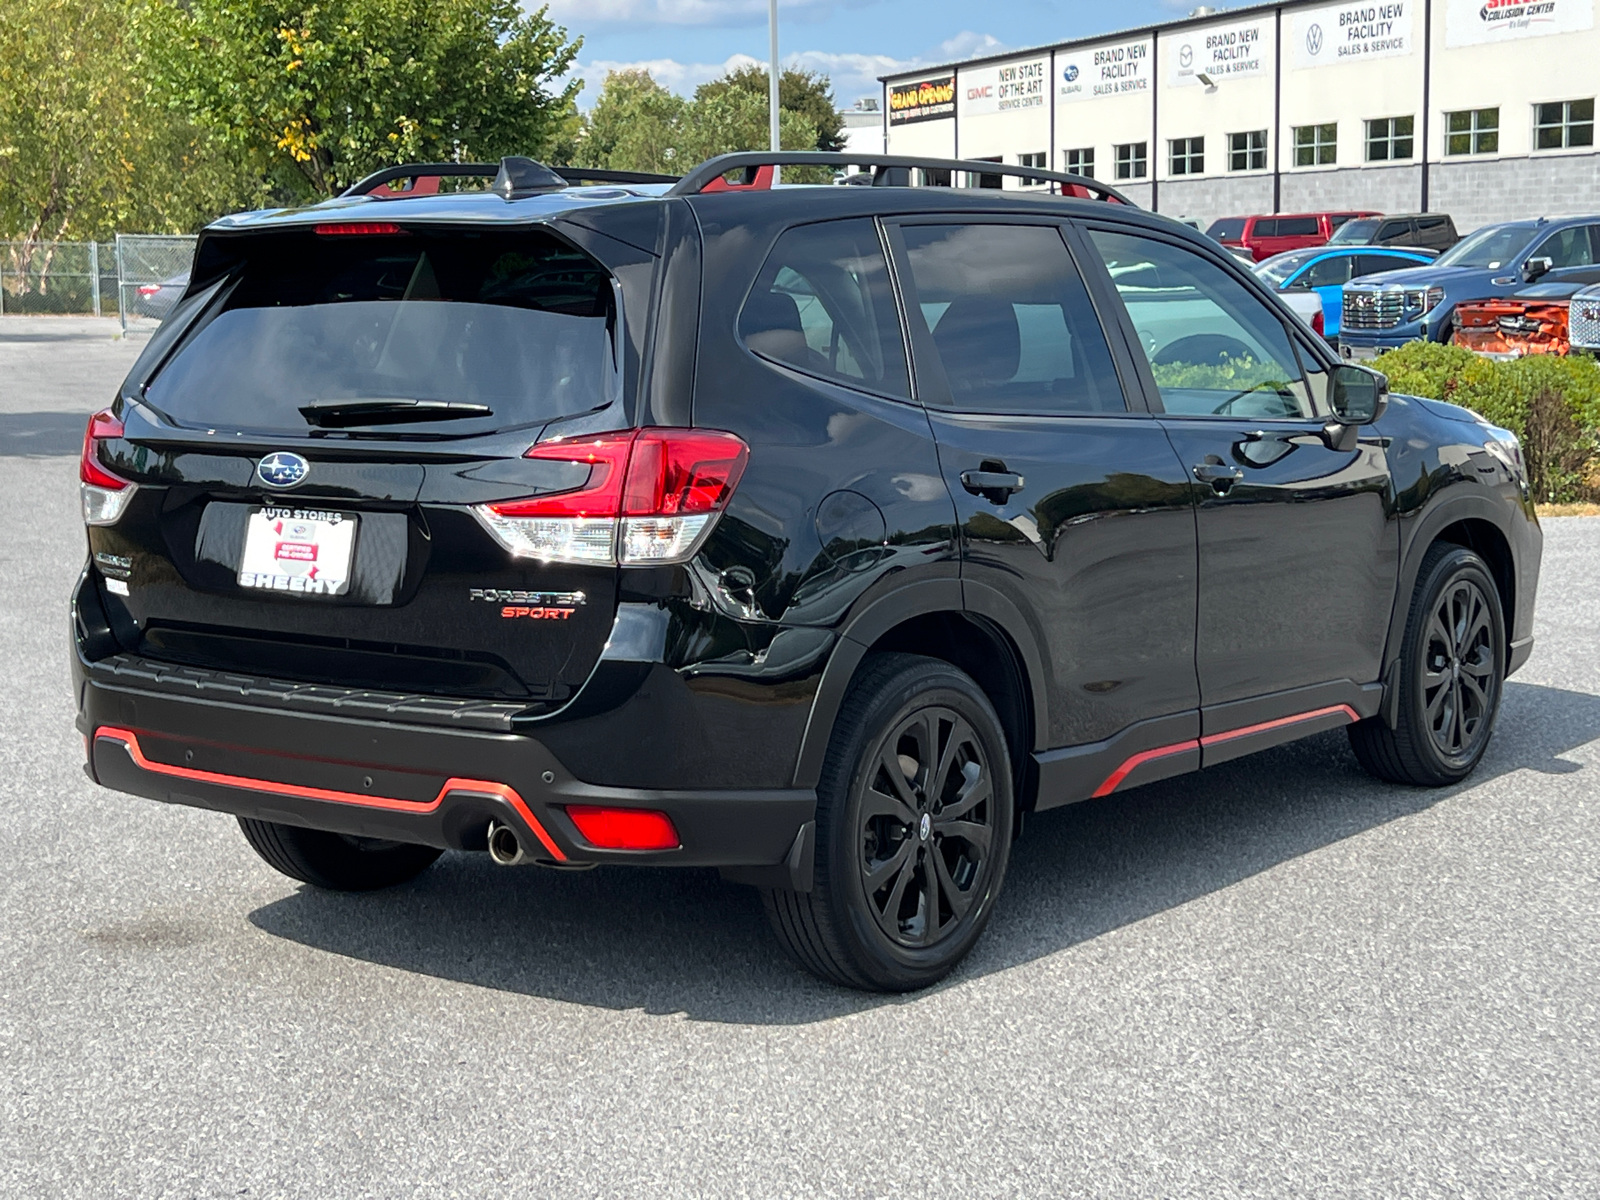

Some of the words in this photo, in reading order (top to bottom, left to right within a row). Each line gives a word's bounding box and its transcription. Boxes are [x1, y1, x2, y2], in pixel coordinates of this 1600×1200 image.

[1339, 8, 1375, 26] BRAND
[1379, 3, 1403, 20] NEW
[1488, 7, 1525, 21] COLLISION
[1526, 2, 1555, 15] CENTER
[1206, 32, 1236, 49] BRAND
[1239, 28, 1259, 43] NEW
[1348, 21, 1393, 41] FACILITY
[1094, 48, 1124, 66] BRAND
[1127, 44, 1147, 59] NEW
[1213, 44, 1250, 62] FACILITY
[1338, 43, 1361, 57] SALES
[1363, 43, 1369, 53] &
[1371, 37, 1403, 52] SERVICE
[999, 67, 1016, 82] NEW
[1019, 62, 1042, 80] STATE
[1101, 61, 1138, 80] FACILITY
[1205, 64, 1224, 75] SALES
[1232, 59, 1259, 72] SERVICE
[967, 85, 993, 101] GMC
[998, 84, 1008, 98] OF
[1010, 81, 1025, 97] THE
[1027, 79, 1042, 94] ART
[1061, 84, 1082, 95] SUBARU
[1093, 82, 1112, 96] SALES
[1120, 78, 1147, 92] SERVICE
[891, 90, 917, 109] GRAND
[919, 84, 954, 105] OPENING
[998, 98, 1020, 110] SERVICE
[1021, 95, 1043, 107] CENTER
[260, 508, 290, 520] AUTO
[294, 510, 342, 522] STORES
[278, 550, 314, 560] PRE-OWNED
[282, 544, 312, 553] CERTIFIED
[241, 572, 342, 594] SHEEHY
[470, 588, 587, 604] FORESTER
[501, 606, 576, 619] SPORT
